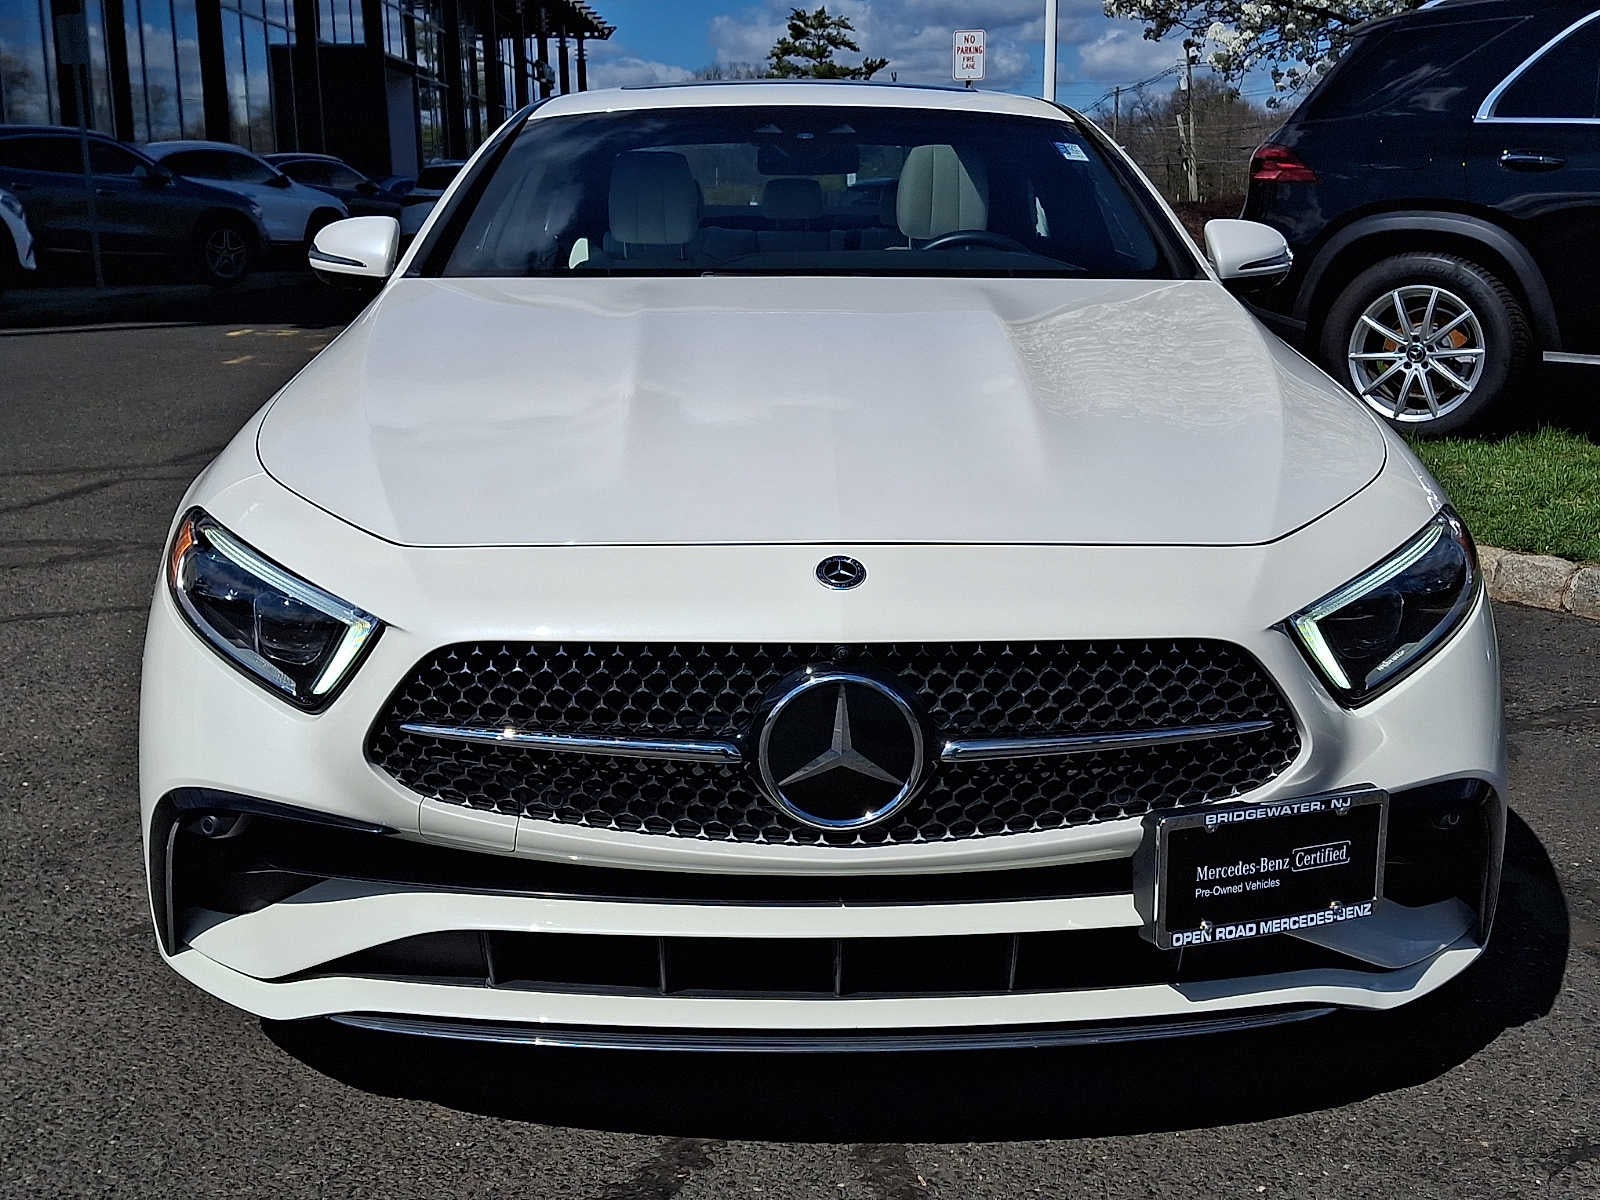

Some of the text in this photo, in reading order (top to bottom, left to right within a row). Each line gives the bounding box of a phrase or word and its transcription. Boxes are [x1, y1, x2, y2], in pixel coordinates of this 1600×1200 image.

[957, 45, 983, 55] PARKING
[964, 35, 975, 44] NO
[1205, 797, 1352, 825] BRIDGEWATER, NJ
[1196, 845, 1347, 882] Mercedes-Benz Certified
[1195, 878, 1280, 899] Pre-Owned Vehicles
[1172, 929, 1213, 947] OPEN
[1215, 923, 1257, 941] ROAD
